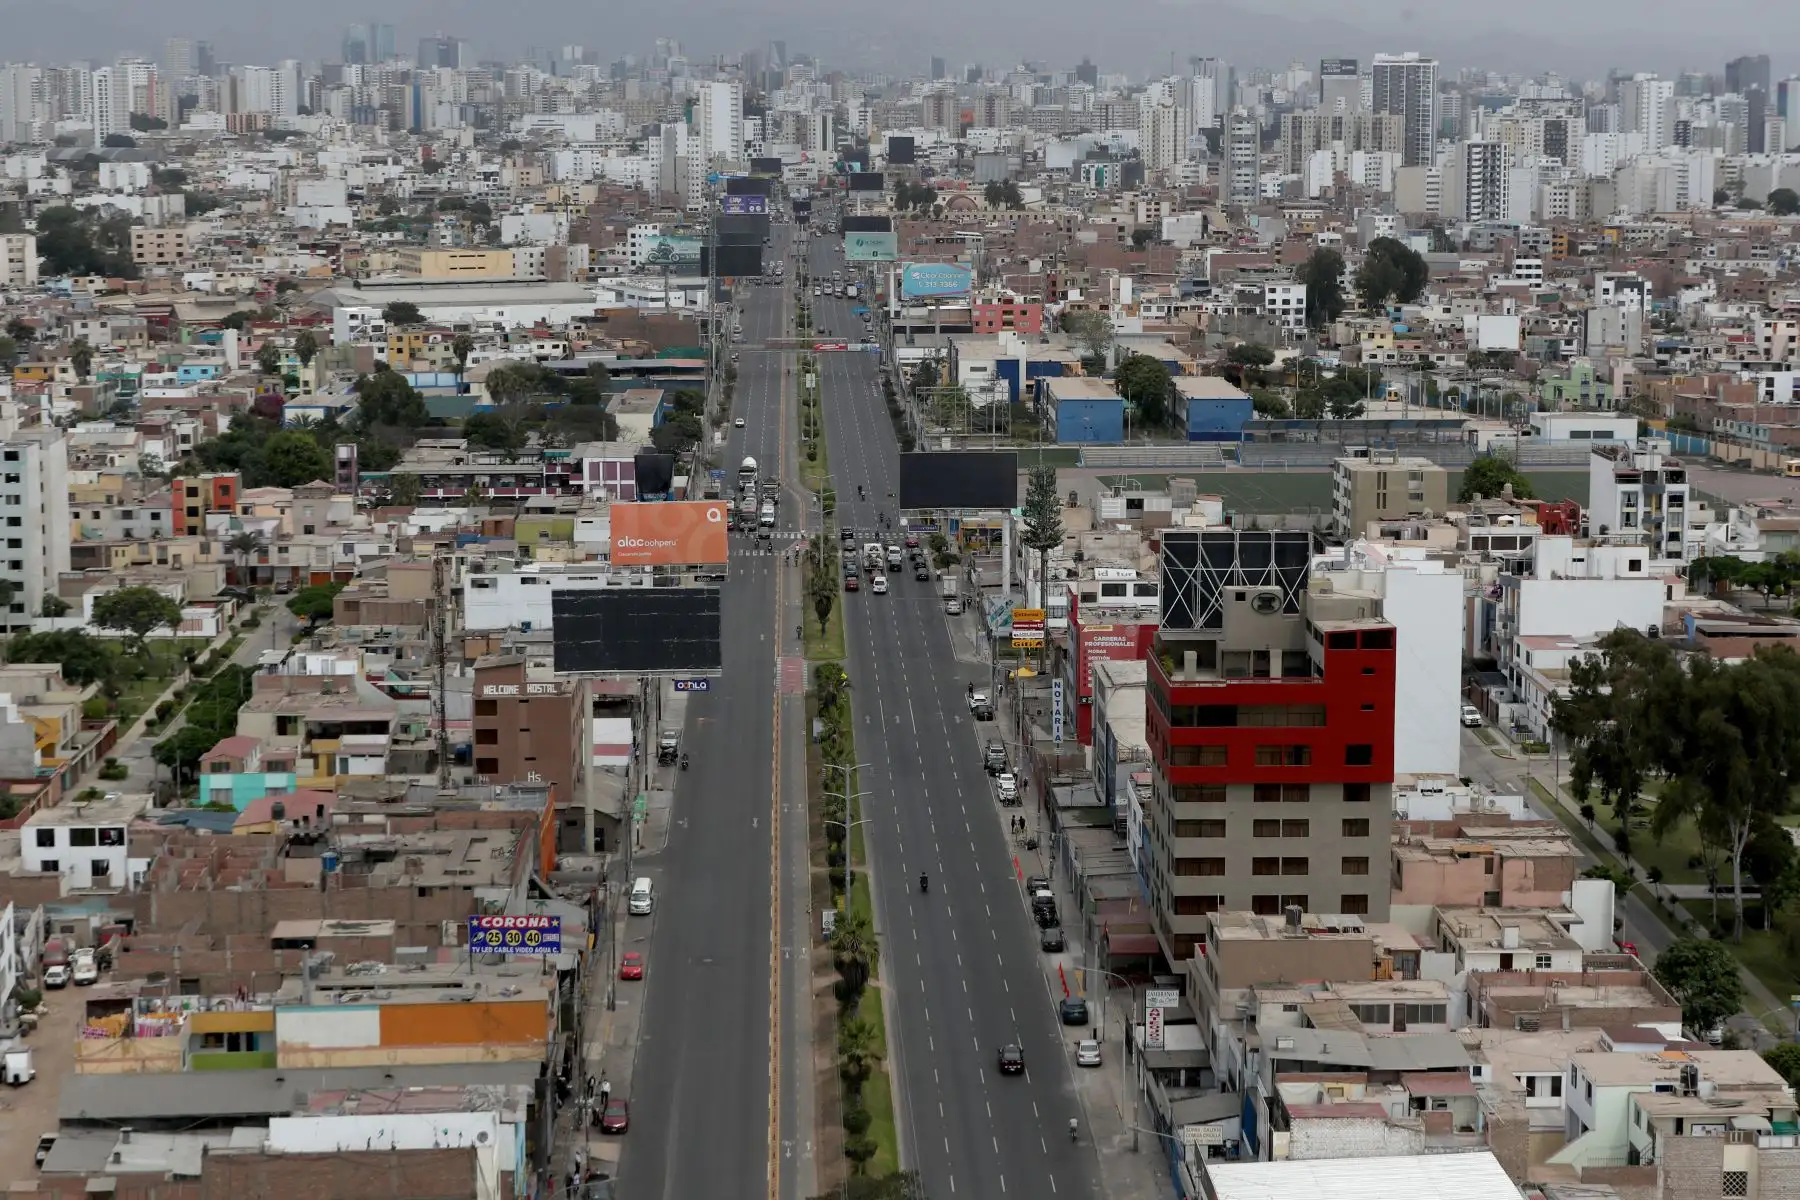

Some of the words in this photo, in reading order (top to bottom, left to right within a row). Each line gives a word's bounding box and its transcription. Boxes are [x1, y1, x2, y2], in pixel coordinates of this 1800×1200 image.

[483, 684, 520, 695] WELCOME
[526, 683, 558, 694] HOSTAL
[1054, 681, 1062, 742] NOTARIA
[481, 917, 549, 928] CORONA
[488, 932, 501, 943] 25
[507, 932, 520, 944] 30
[526, 932, 540, 944] 40
